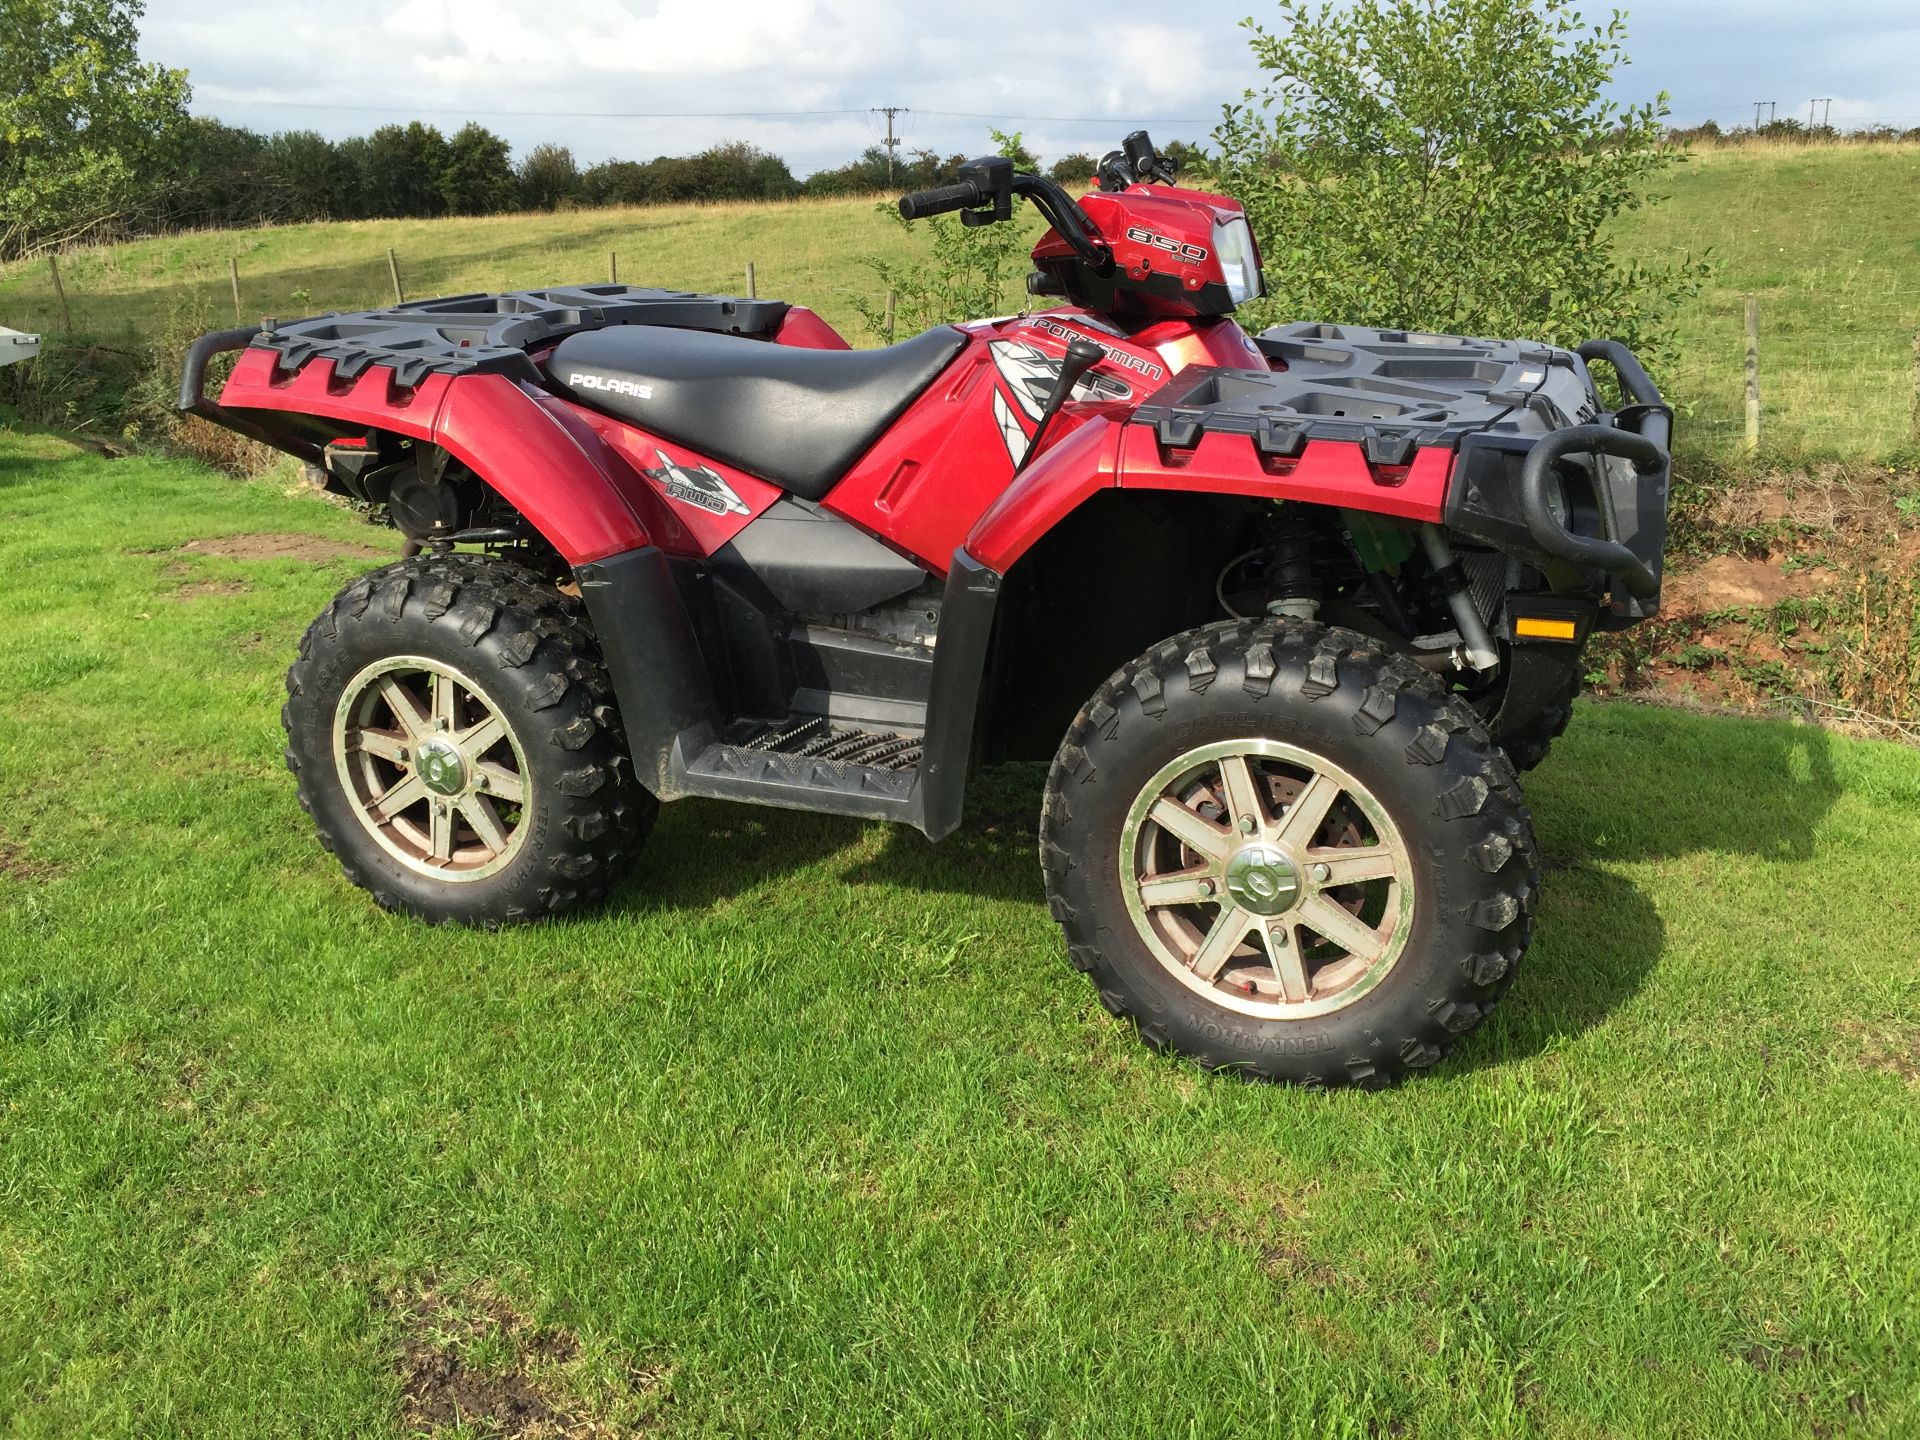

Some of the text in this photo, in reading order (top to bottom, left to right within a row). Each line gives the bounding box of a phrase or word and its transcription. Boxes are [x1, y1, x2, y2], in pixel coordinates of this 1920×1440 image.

[1126, 227, 1208, 261] 850
[569, 373, 653, 400] POLARIS
[665, 482, 728, 515] AWD
[1184, 1011, 1336, 1056] TERRATHON
